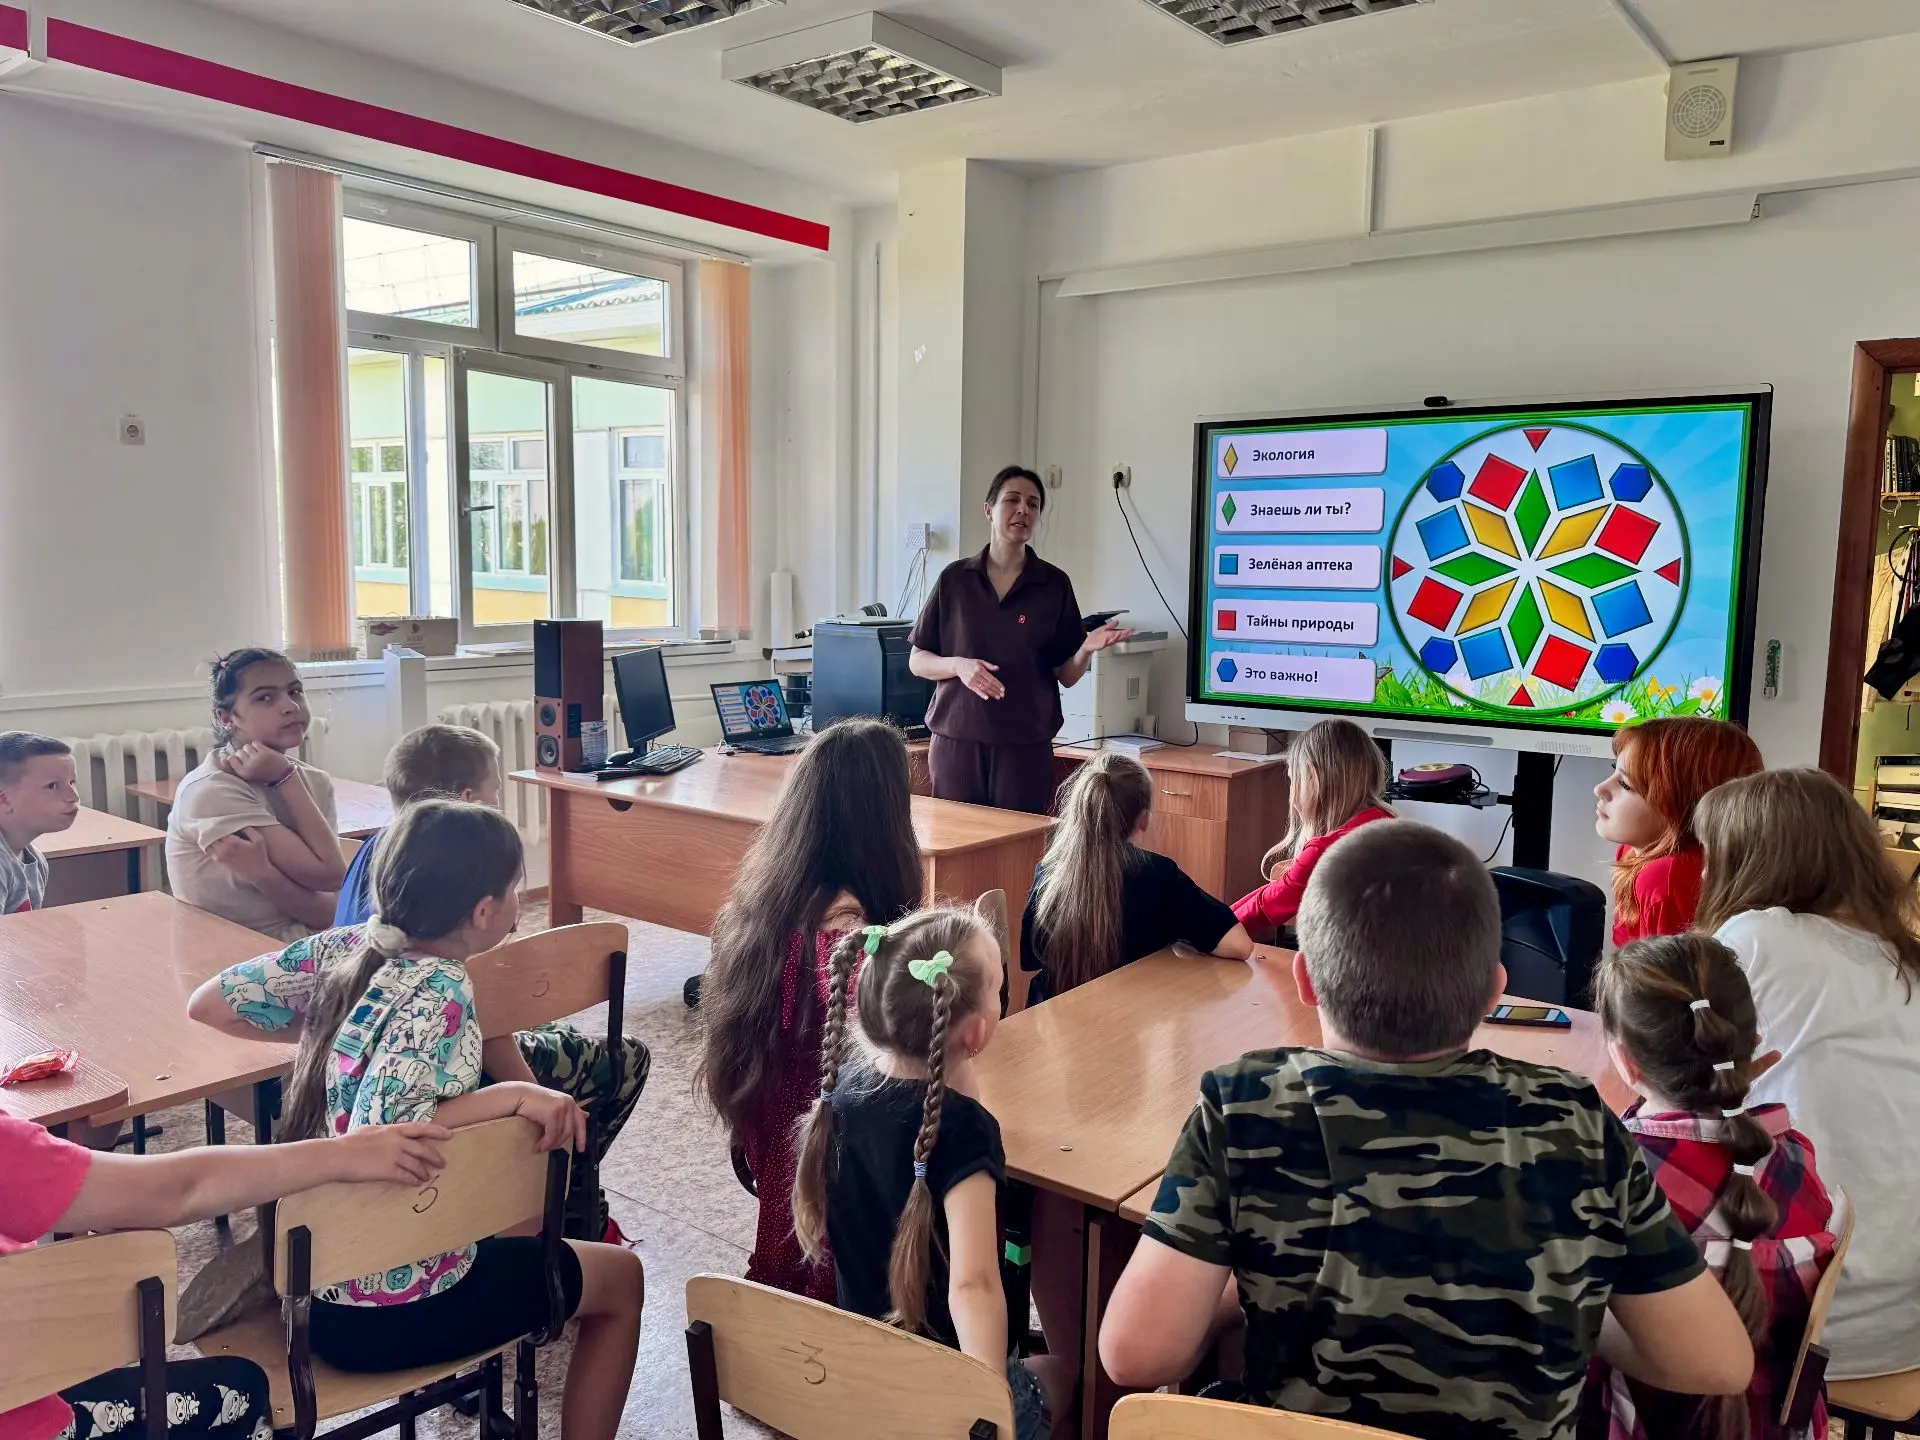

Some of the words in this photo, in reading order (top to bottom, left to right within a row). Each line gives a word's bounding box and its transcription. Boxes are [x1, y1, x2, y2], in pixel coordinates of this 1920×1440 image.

[1252, 450, 1315, 462] Экология
[1250, 504, 1301, 516] Знаешь
[1304, 505, 1322, 516] ли
[1326, 502, 1352, 516] ты?
[1248, 558, 1303, 570] Зелёная
[1306, 560, 1353, 571] аптека
[1246, 614, 1288, 628] Тайны
[1291, 618, 1354, 632] природы
[1244, 667, 1266, 680] Это
[1270, 670, 1318, 683] важно!
